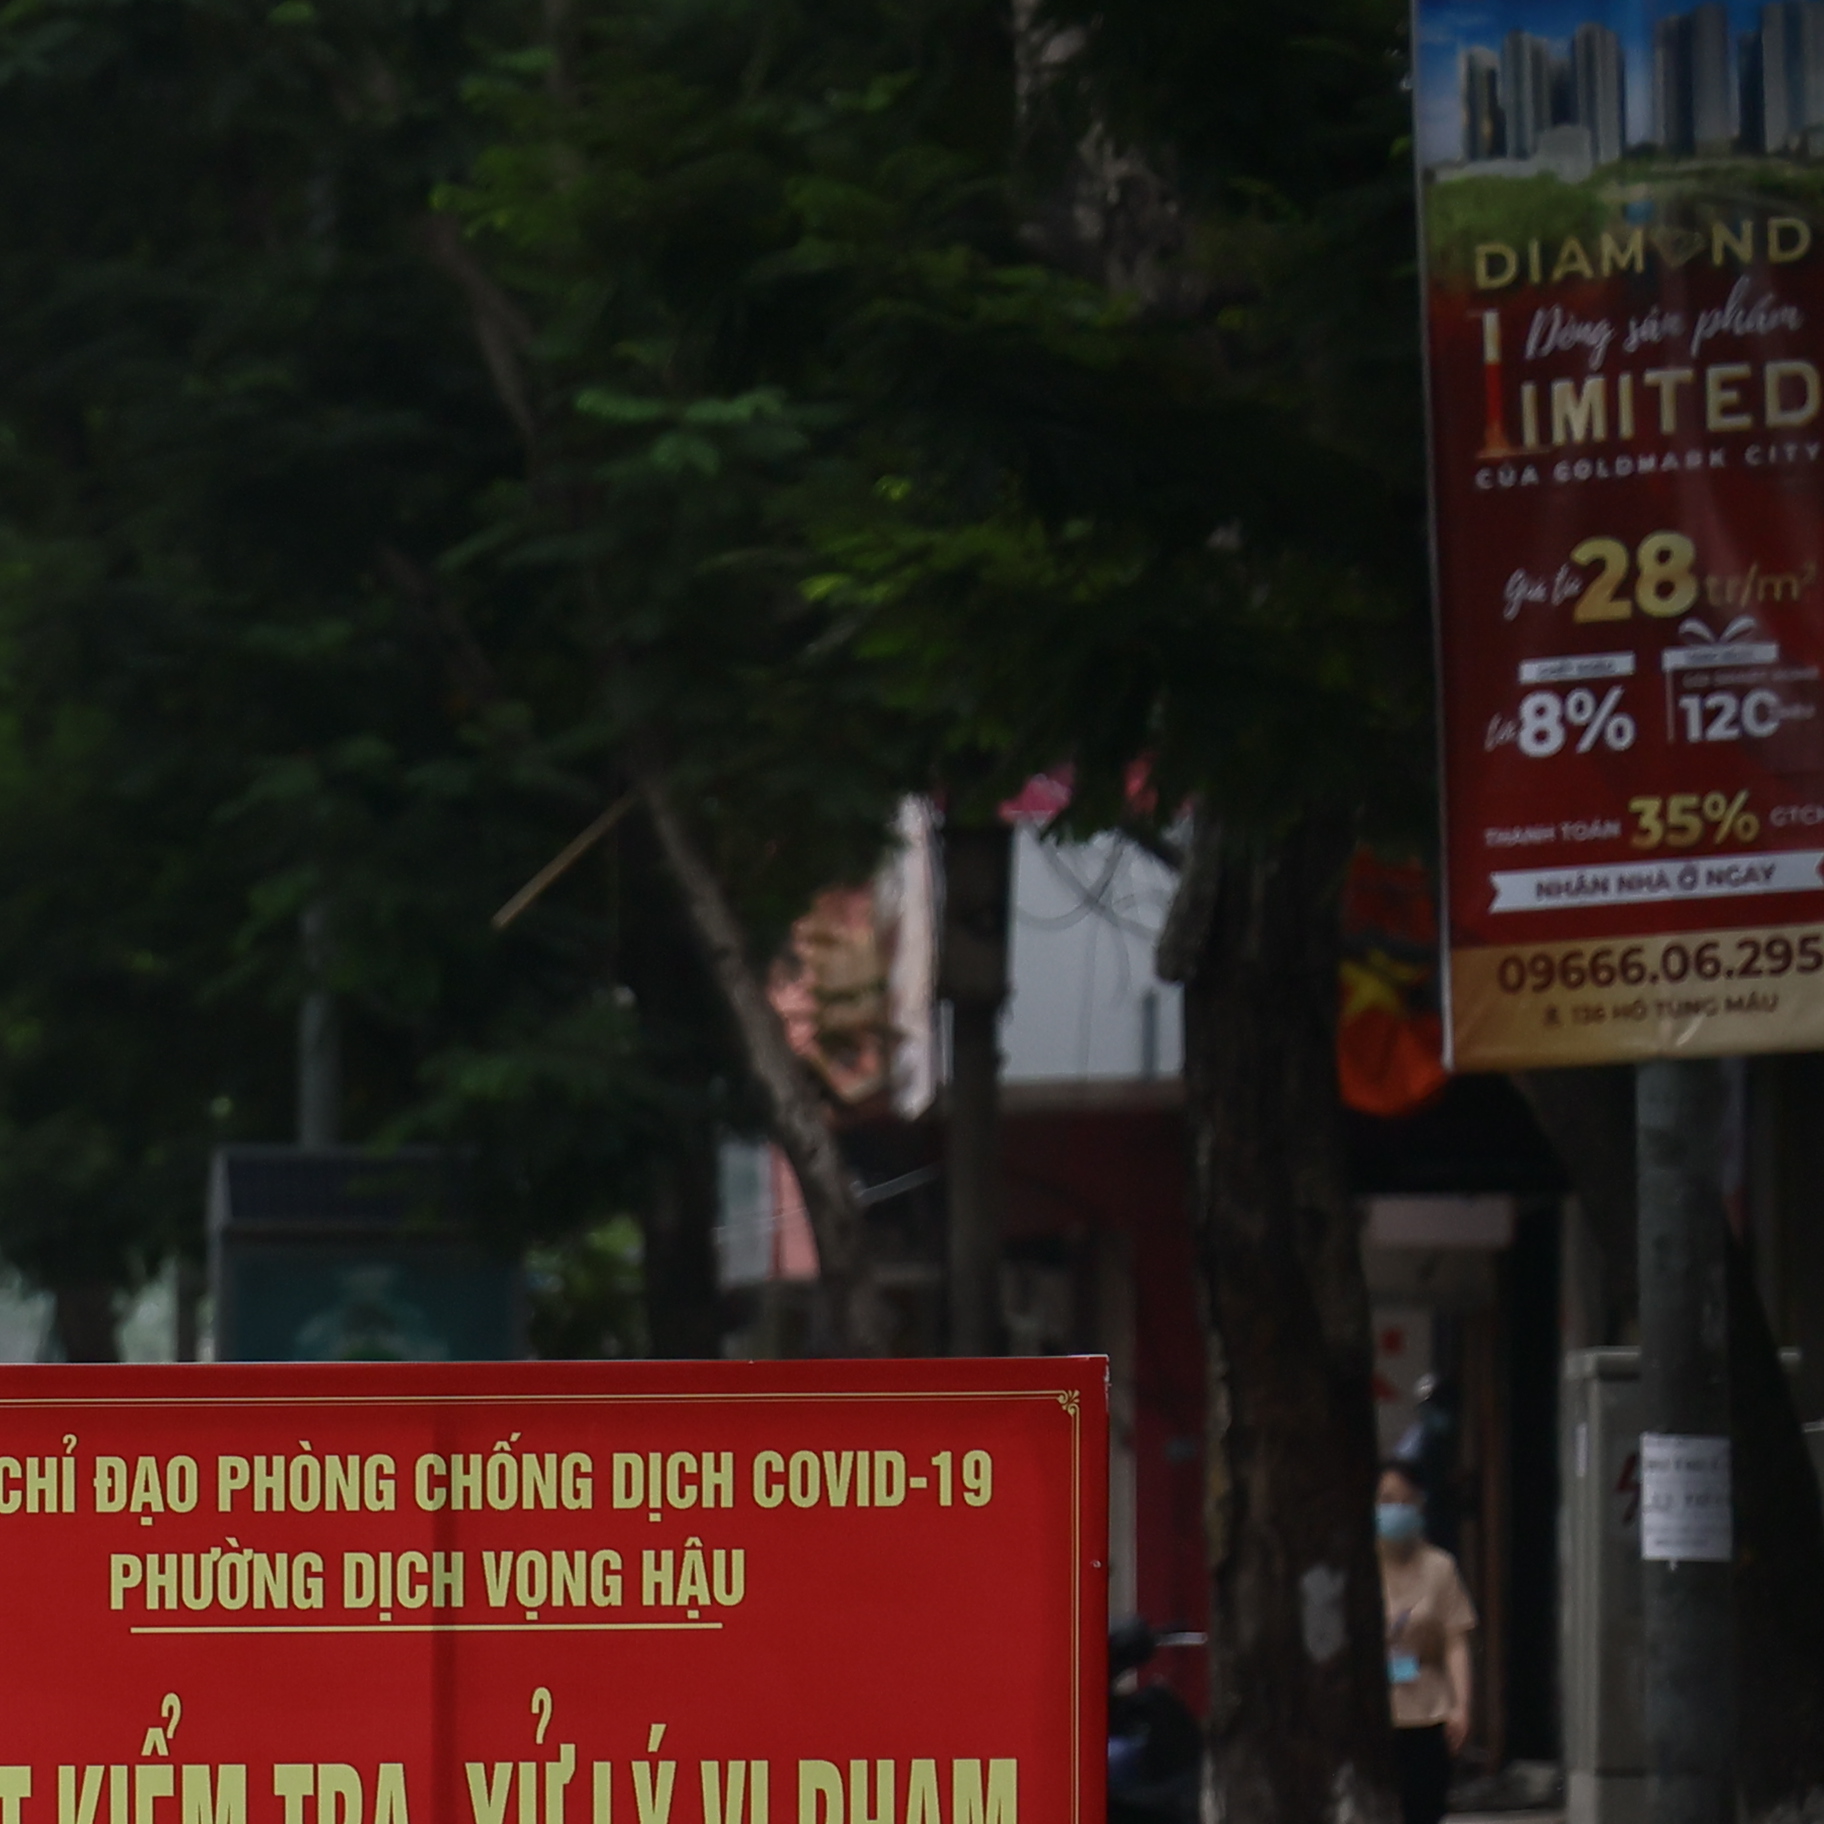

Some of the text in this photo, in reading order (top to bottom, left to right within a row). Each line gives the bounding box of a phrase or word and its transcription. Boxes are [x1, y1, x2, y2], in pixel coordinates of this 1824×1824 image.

[1743, 441, 1822, 467] CITY
[1570, 529, 1701, 624] 28
[1517, 684, 1638, 759] 8%
[1628, 789, 1762, 850] 35%
[1497, 932, 1824, 995] 09666.06.295
[93, 1455, 198, 1526] ĐẠO
[217, 1440, 396, 1513] PHÒNG
[415, 1432, 593, 1512] CHỐNG
[612, 1451, 734, 1522] DỊCH
[753, 1449, 992, 1509] COVID-19
[110, 1536, 745, 1620] PHƯỜNG DỊCH VỌNG HẬU
